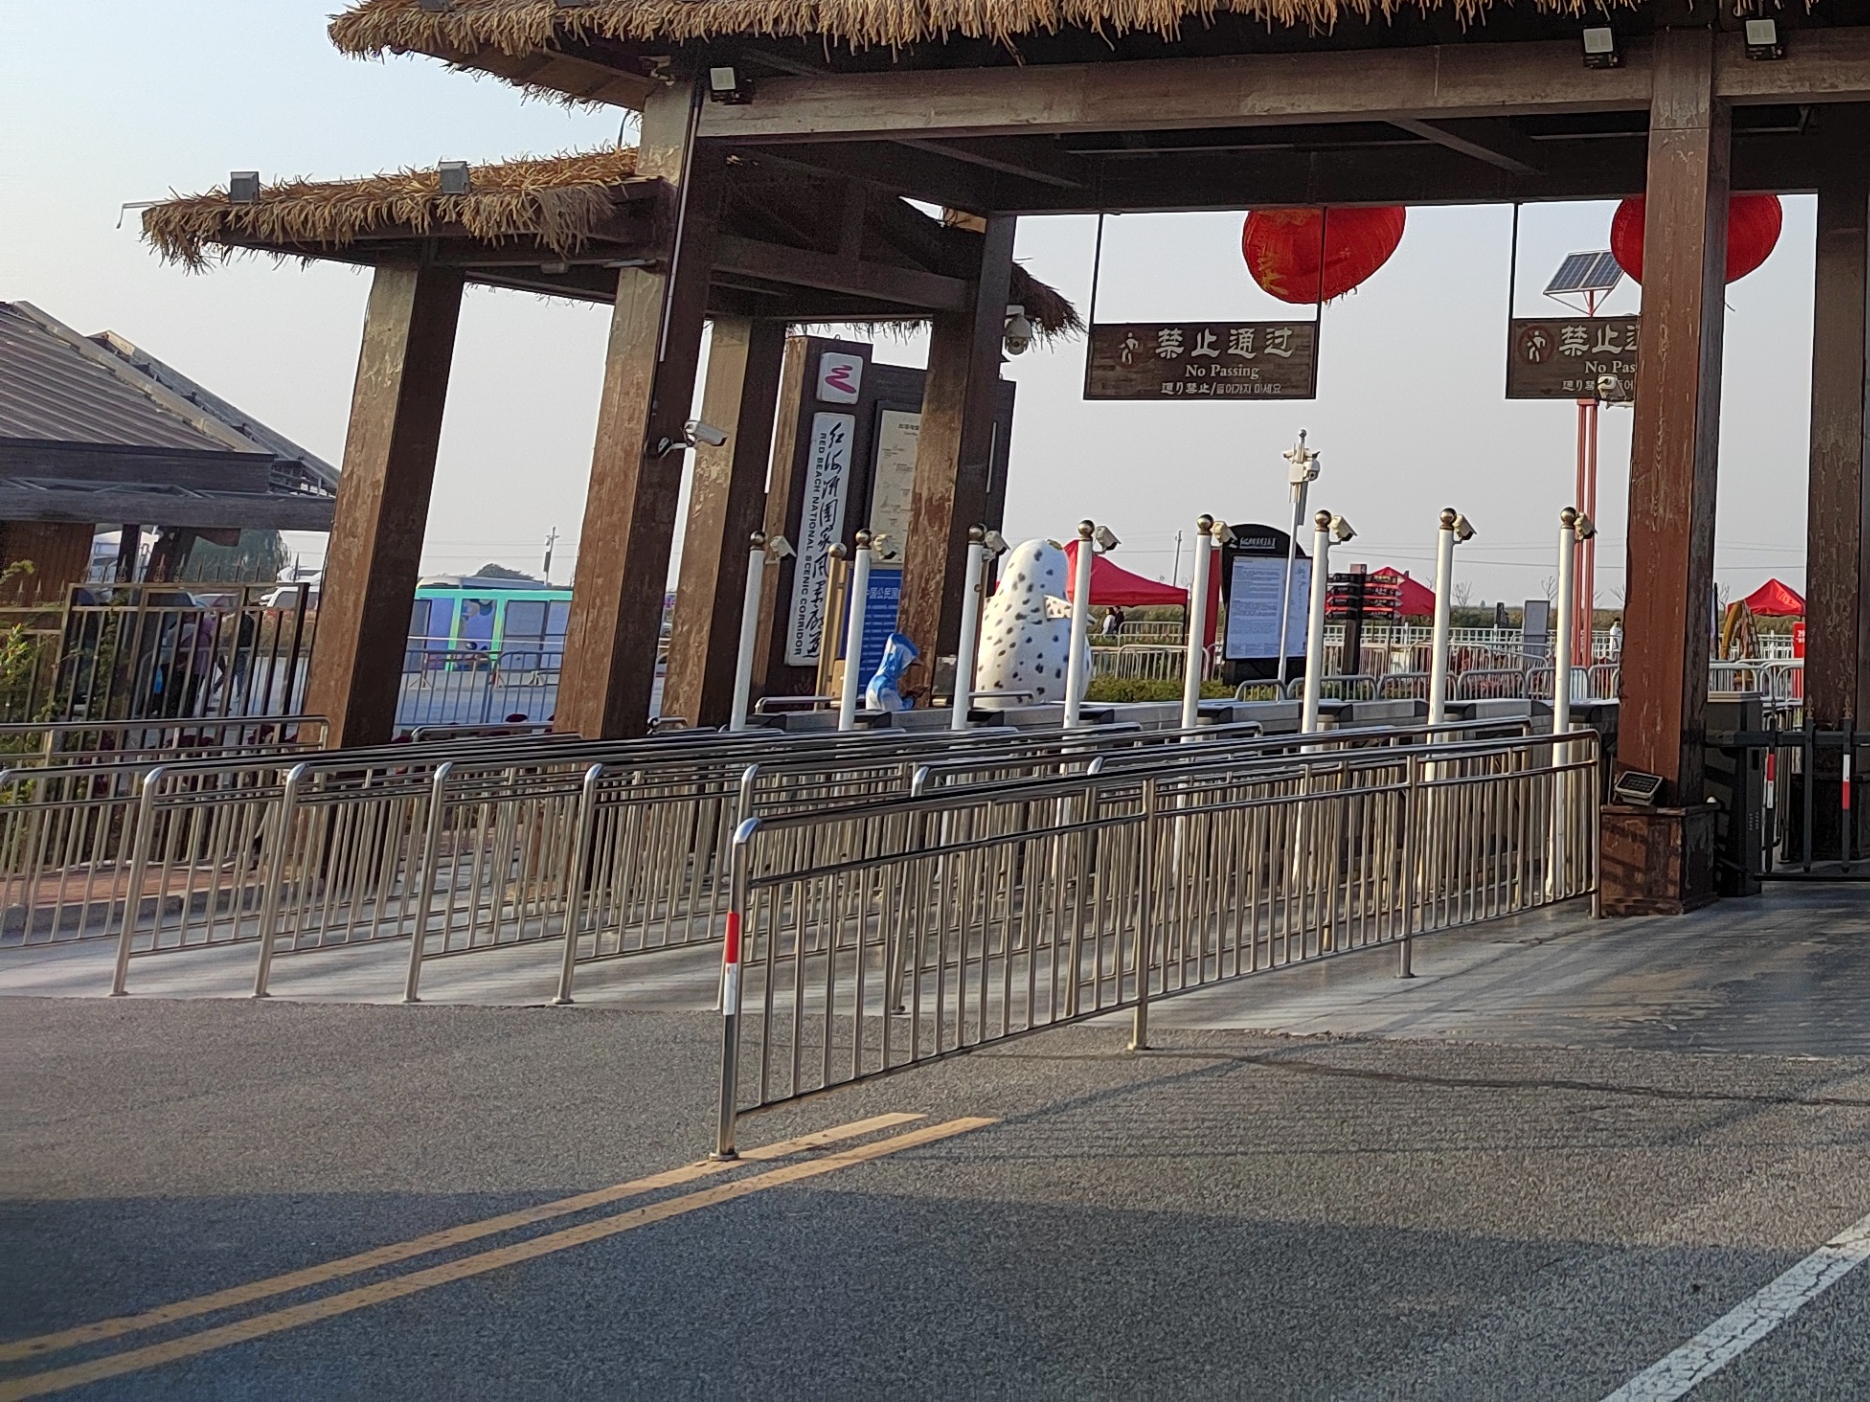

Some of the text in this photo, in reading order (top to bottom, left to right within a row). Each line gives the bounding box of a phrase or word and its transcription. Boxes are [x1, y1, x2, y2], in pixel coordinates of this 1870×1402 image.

[1155, 326, 1295, 360] 禁止通过
[1184, 363, 1260, 380] No Passing
[1584, 360, 1637, 374] No Pas
[793, 432, 828, 656] RED BEACH NATIONAL SCENIC CORRIDOR
